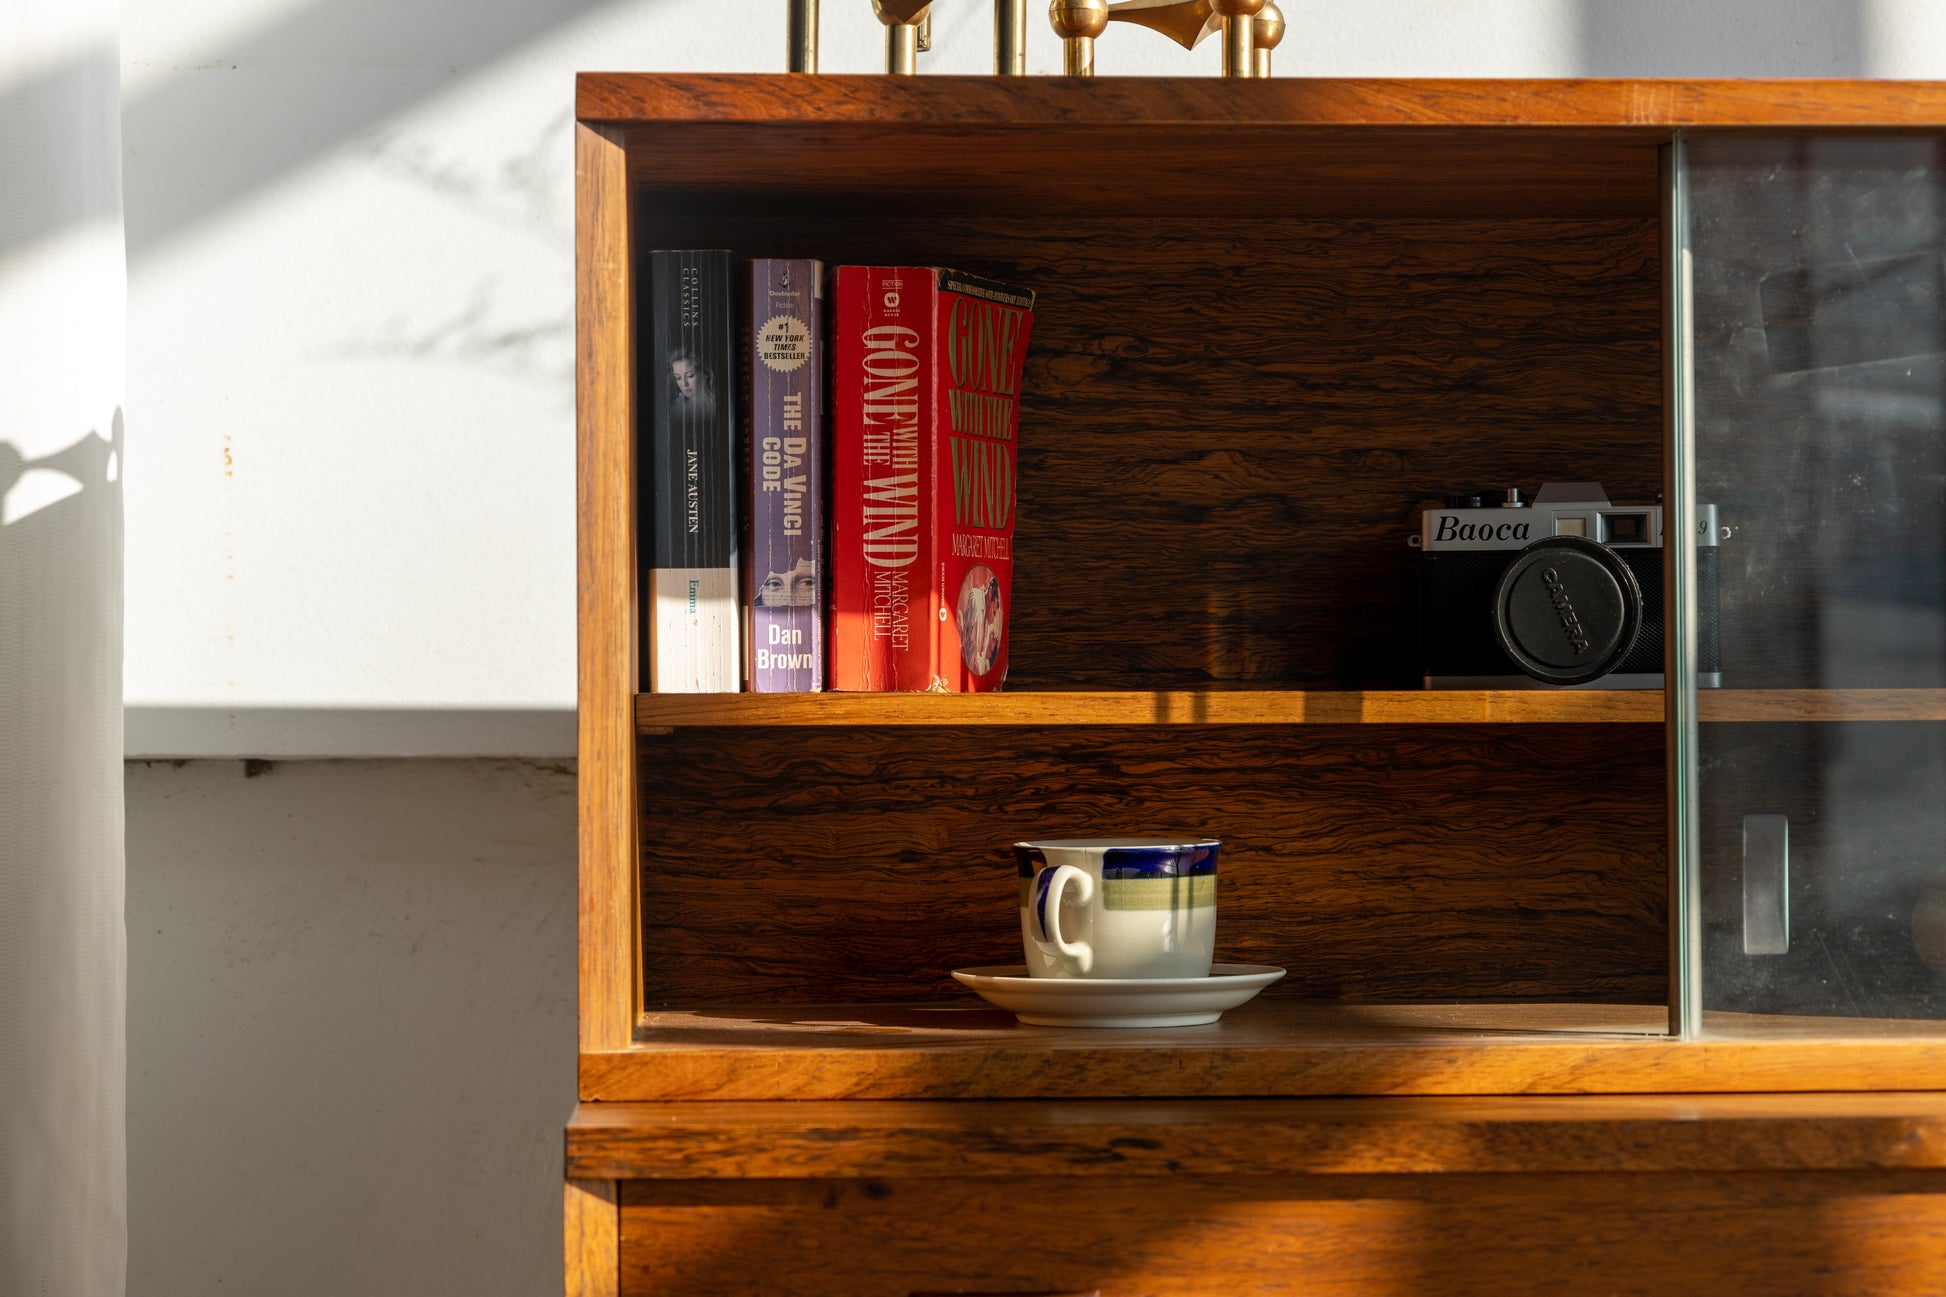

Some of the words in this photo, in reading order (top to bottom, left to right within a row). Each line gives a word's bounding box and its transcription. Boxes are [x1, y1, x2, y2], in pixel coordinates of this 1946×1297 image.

[691, 267, 699, 327] COLLINS
[775, 301, 795, 309] Fiction
[765, 334, 783, 343] NEW
[784, 334, 805, 343] YORK
[778, 321, 790, 333] #1
[763, 351, 806, 361] BESTSELLER
[773, 343, 797, 351] TIMES
[948, 297, 1023, 396] GONE
[862, 325, 920, 425] GONE
[783, 392, 802, 431] THE
[948, 389, 985, 438] WITH
[985, 395, 1013, 442] THE
[762, 436, 782, 492] CODE
[783, 437, 807, 469] DA
[863, 431, 891, 466] THE
[892, 425, 918, 469] WITH
[687, 449, 699, 483] JANE
[949, 436, 1012, 530] WIND
[688, 484, 699, 533] AUSTEN
[783, 475, 807, 536] VINCI
[863, 469, 919, 568] WIND
[1434, 515, 1530, 541] Baoca
[951, 533, 984, 559] MARGARET
[984, 536, 1010, 561] MITCHELL
[688, 579, 700, 614] Emma
[874, 571, 891, 641] MITCHELL
[892, 571, 909, 652] MARGARET
[768, 624, 802, 645] Dan
[757, 649, 813, 669] Brown
